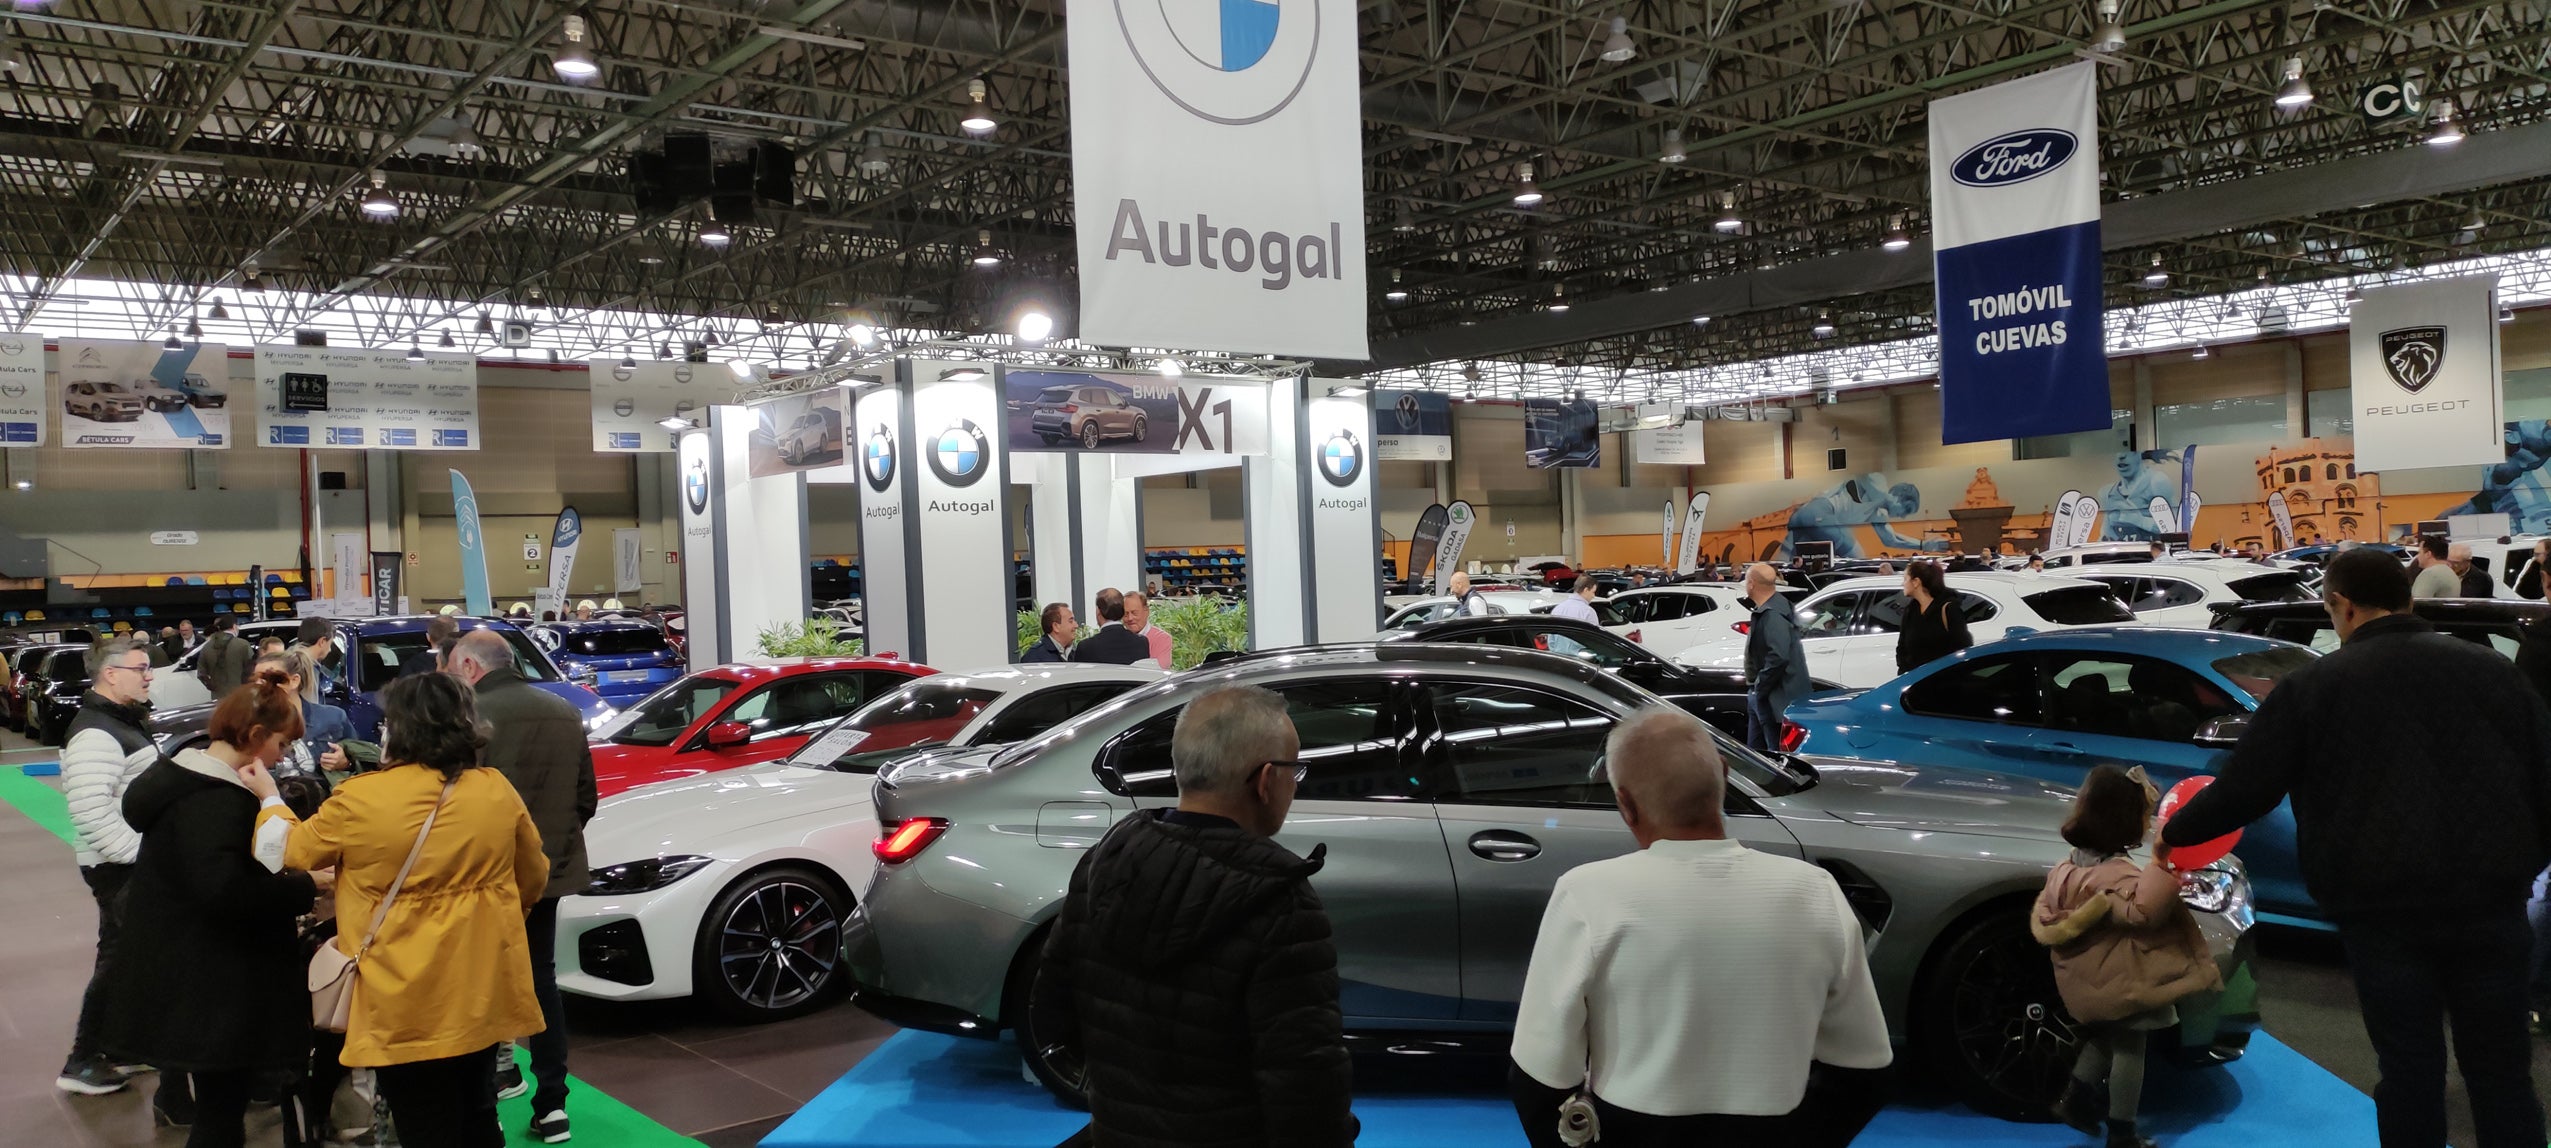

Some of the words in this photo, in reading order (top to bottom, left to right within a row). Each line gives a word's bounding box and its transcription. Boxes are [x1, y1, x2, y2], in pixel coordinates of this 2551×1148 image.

[2364, 84, 2401, 117] C
[2403, 81, 2421, 112] C
[1975, 138, 2052, 181] Ford
[1105, 198, 1342, 290] Autogal
[1968, 284, 2072, 321] TOMÓVIL
[507, 325, 528, 343] D
[1976, 320, 2067, 355] CUEVAS
[2385, 331, 2440, 342] PEUGEOT
[1132, 385, 1169, 400] BMW
[1168, 386, 1232, 454] X1
[2366, 399, 2470, 416] PEUGEOT
[866, 502, 900, 520] Autogal
[928, 499, 994, 516] Autogal
[1319, 497, 1367, 511] Autogal
[688, 524, 712, 537] Autogal
[2077, 522, 2091, 543] ersa
[1437, 530, 1458, 572] ŠKODA
